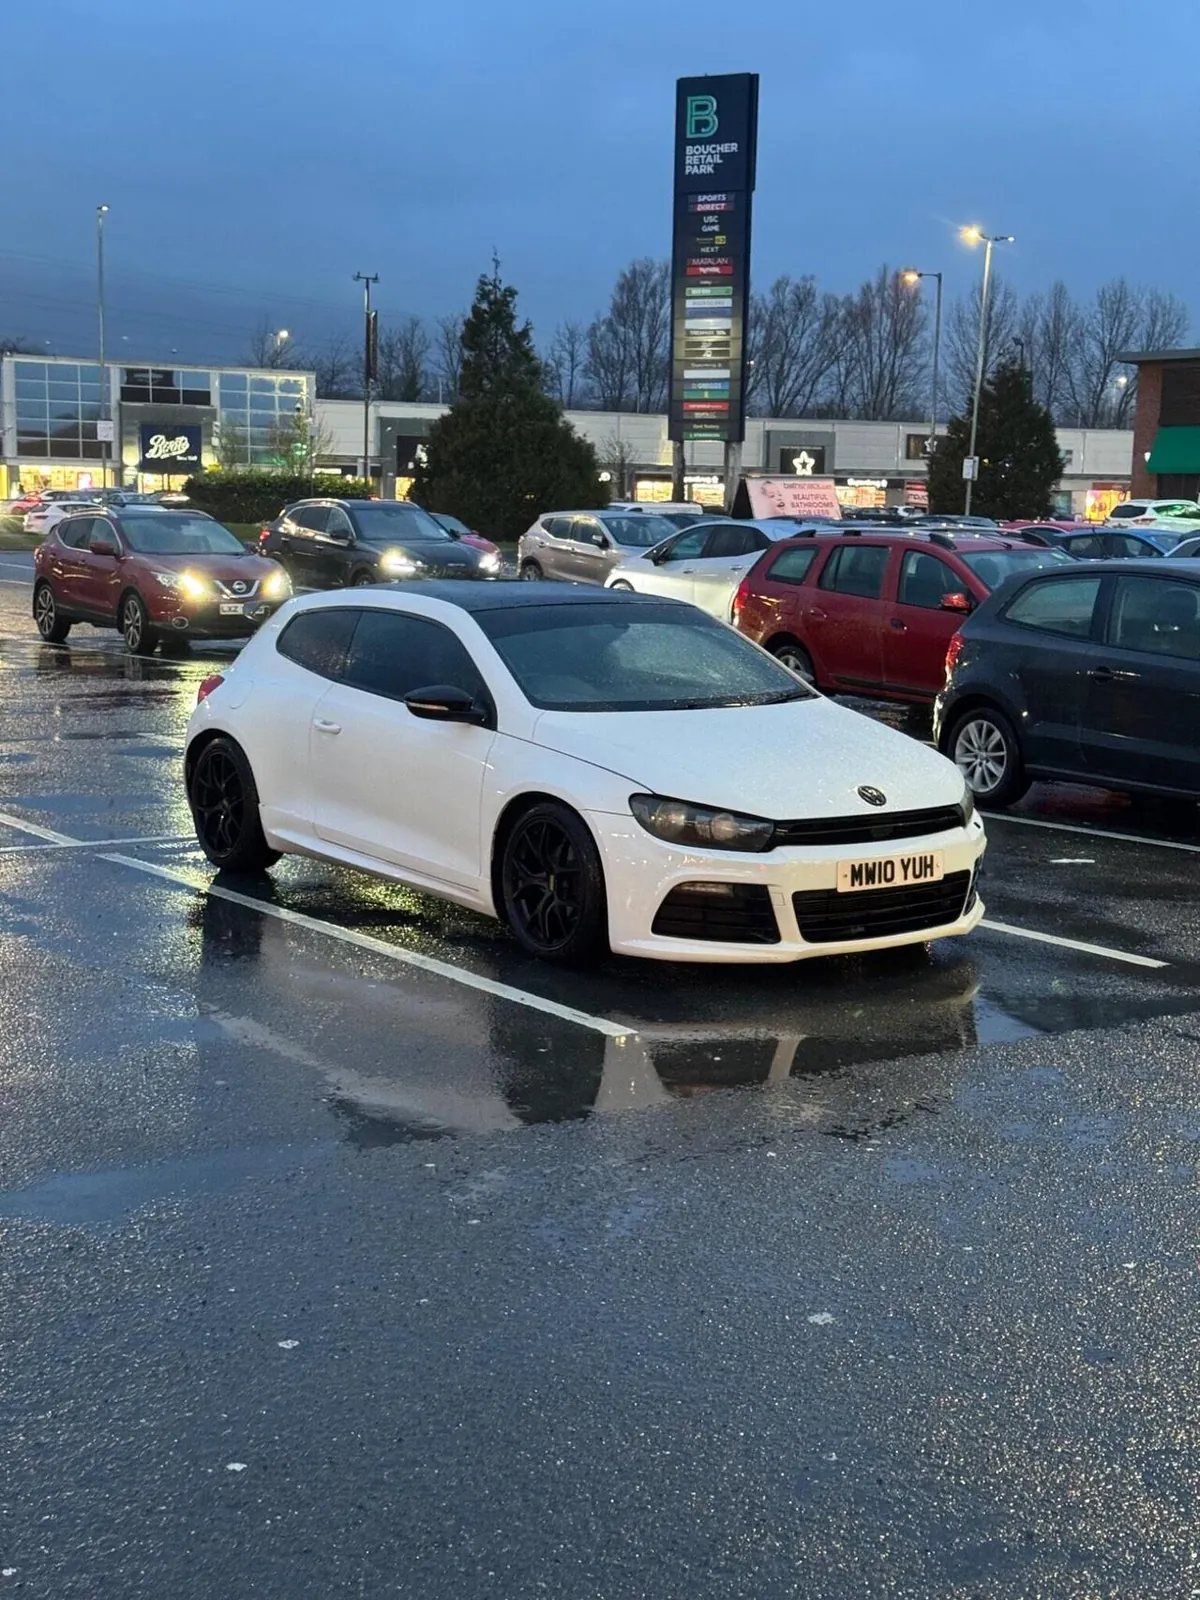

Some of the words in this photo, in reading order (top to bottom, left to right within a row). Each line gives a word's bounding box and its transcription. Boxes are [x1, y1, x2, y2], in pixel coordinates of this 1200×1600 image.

[685, 143, 738, 155] BOUCHER
[685, 154, 723, 165] RETAIL
[685, 164, 714, 175] PARK
[697, 194, 726, 202] SPORTS
[696, 203, 726, 212] DIRECT
[145, 434, 190, 459] Boots
[792, 493, 829, 501] BEAUTIFUL
[791, 501, 835, 509] BATHROOMS
[850, 860, 895, 886] MW10
[900, 855, 934, 880] YUH
